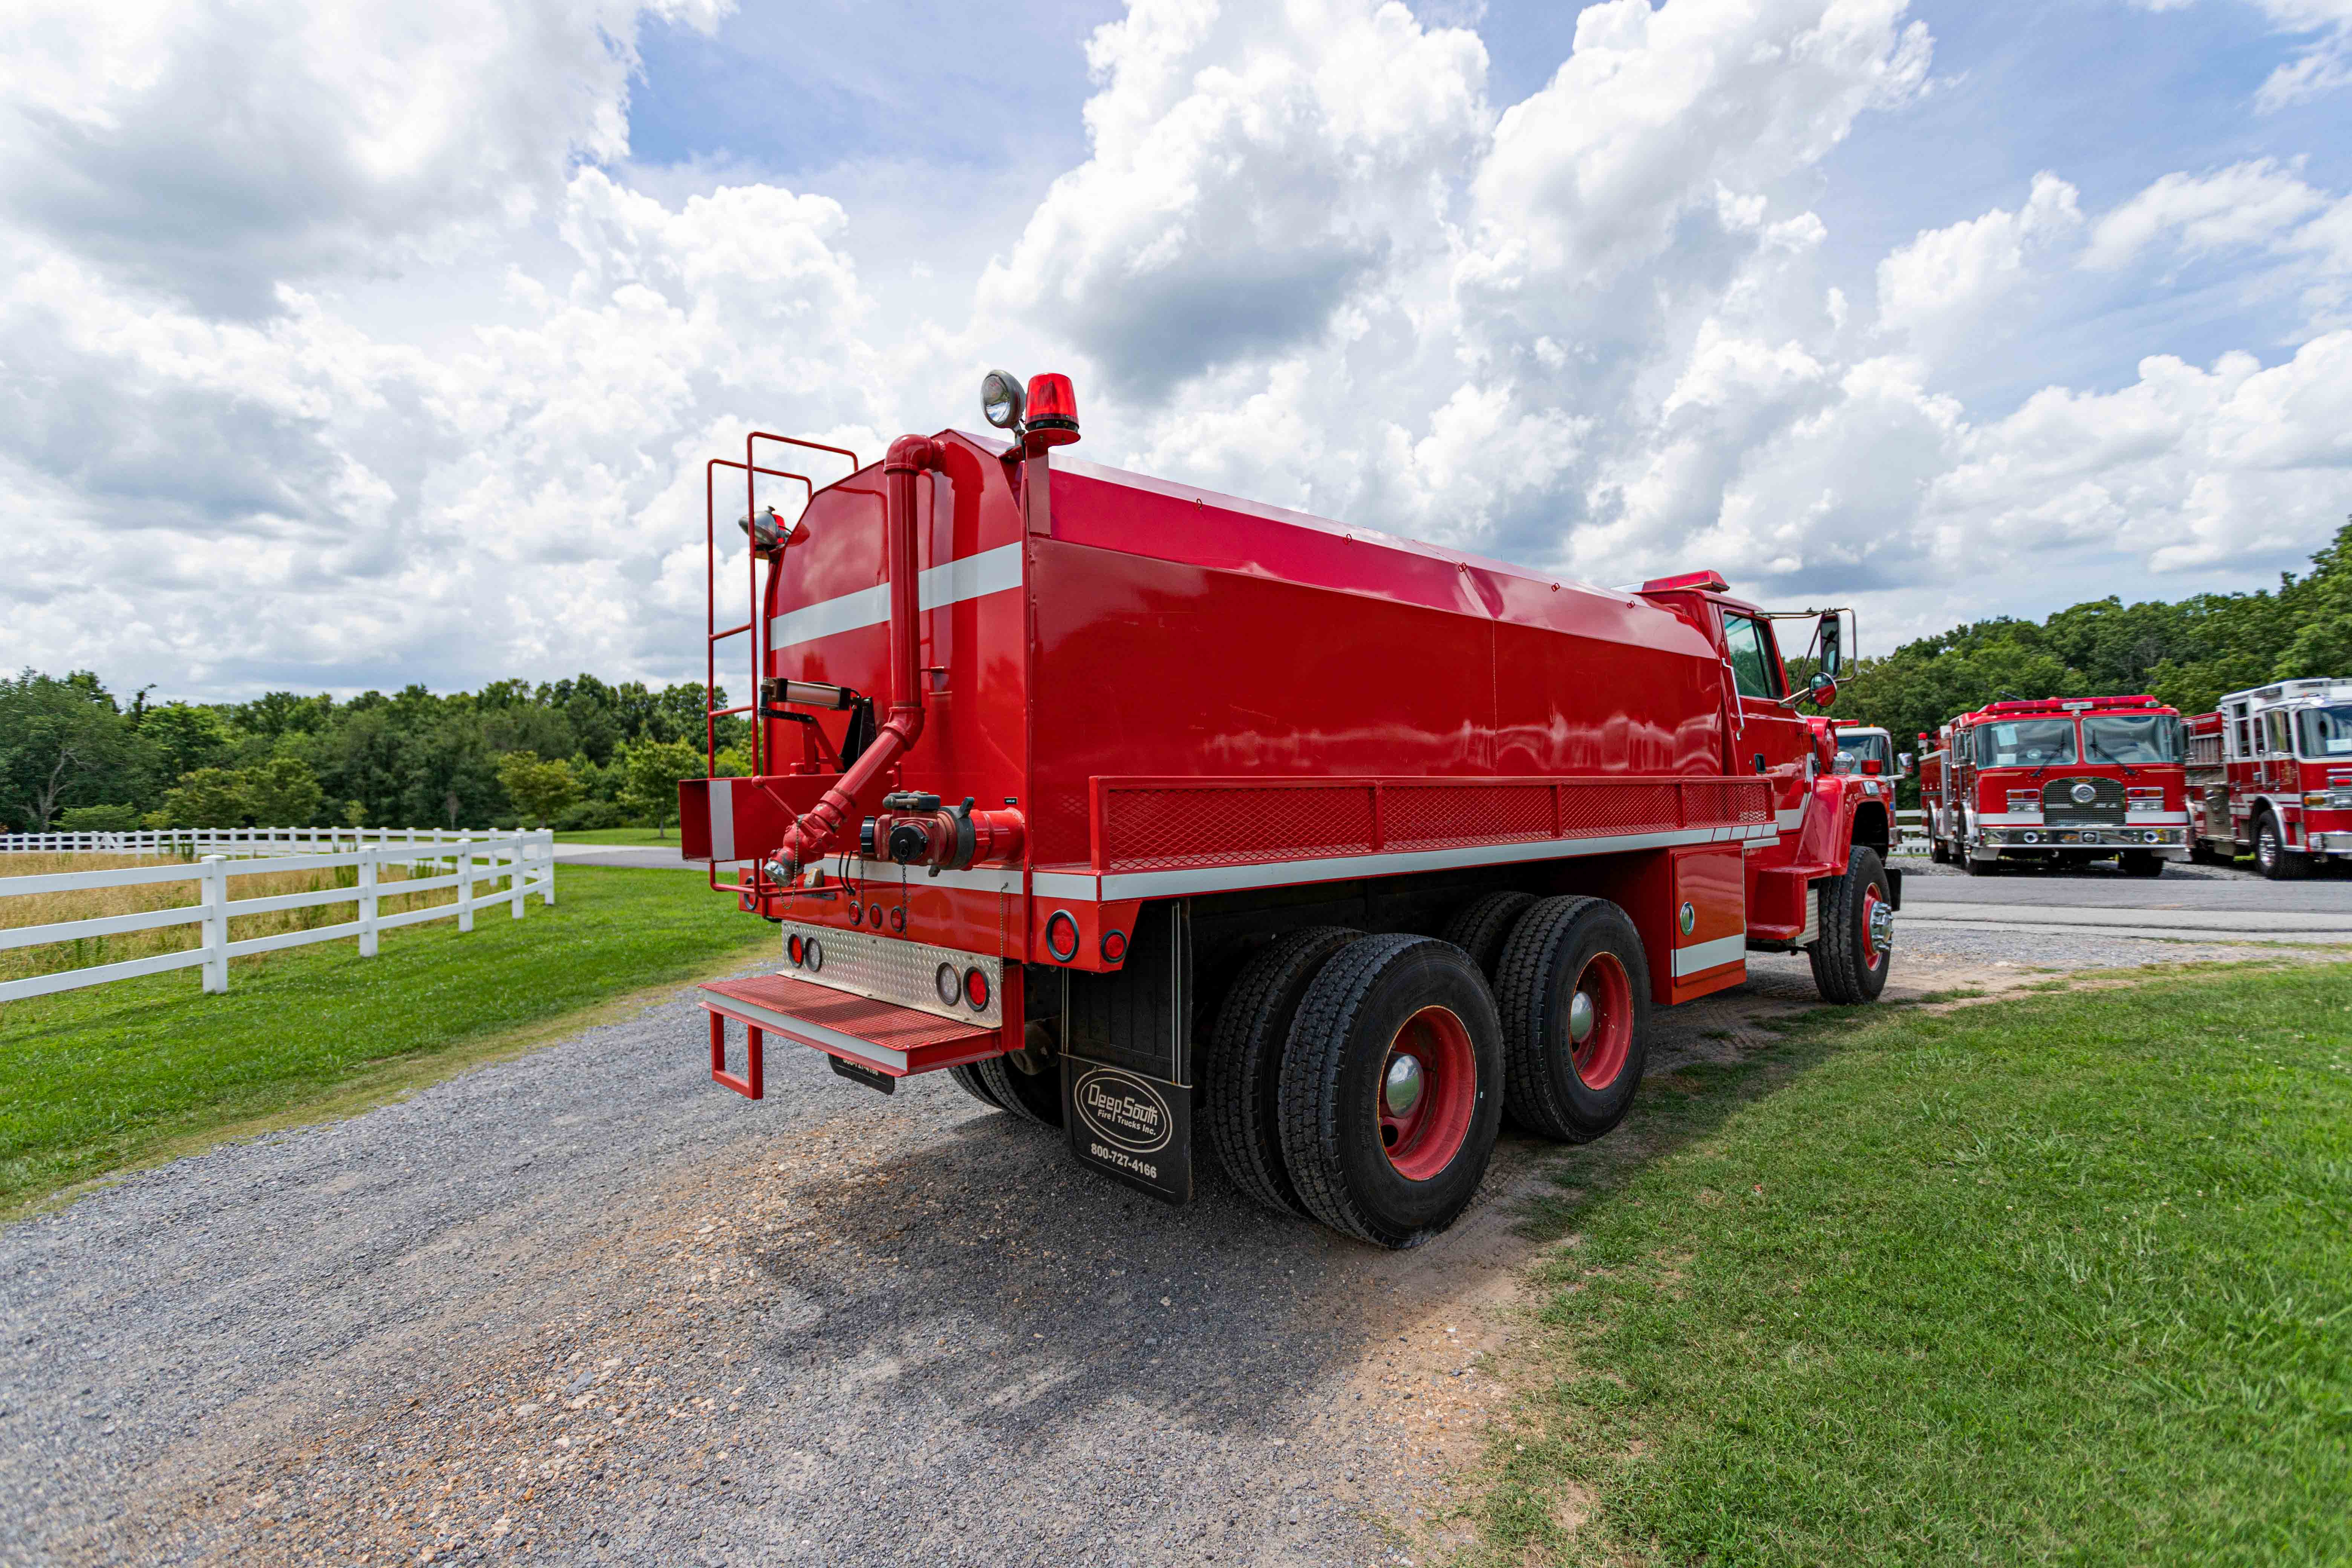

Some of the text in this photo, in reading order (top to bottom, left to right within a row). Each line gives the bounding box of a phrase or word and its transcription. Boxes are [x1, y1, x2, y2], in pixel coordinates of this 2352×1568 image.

[1098, 1109, 1156, 1136] Fire Trucks Inc.
[1091, 1143, 1157, 1179] 800-727-4166
